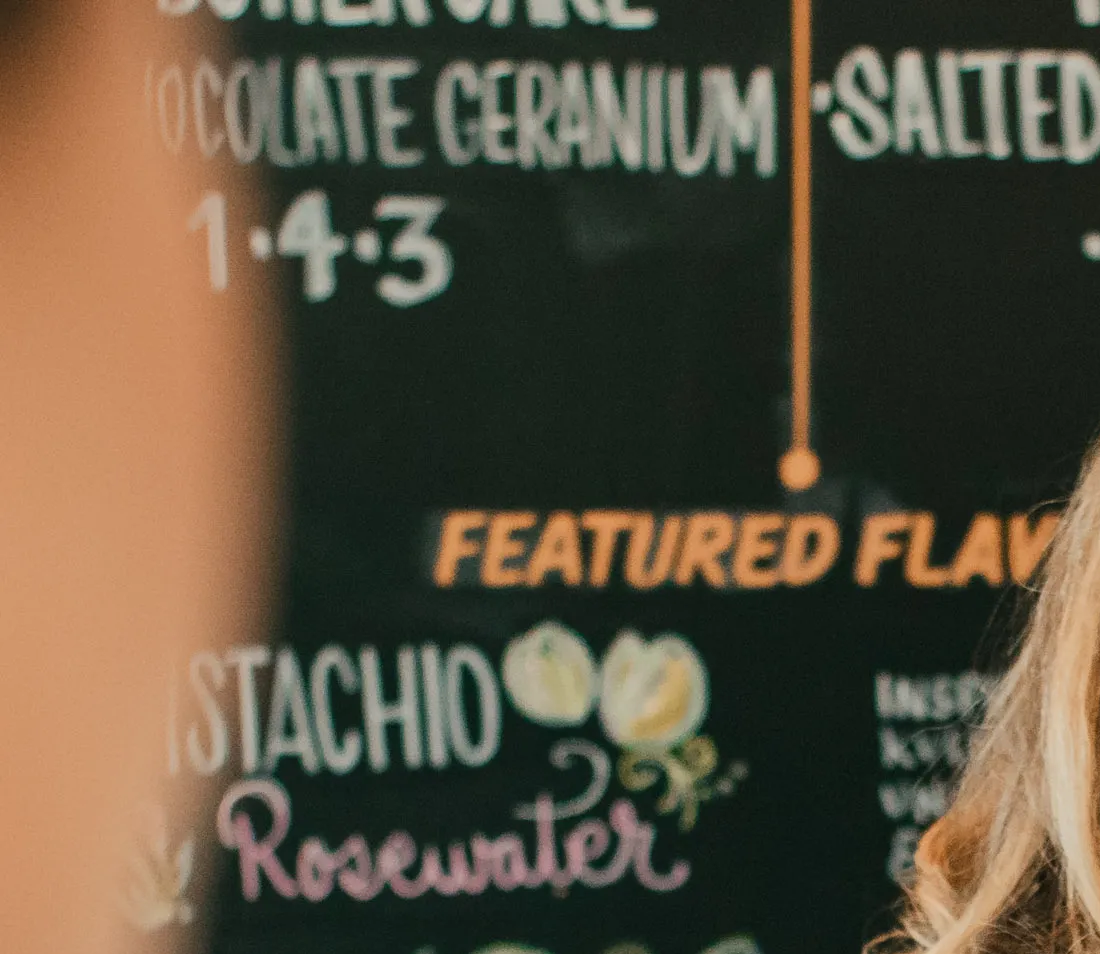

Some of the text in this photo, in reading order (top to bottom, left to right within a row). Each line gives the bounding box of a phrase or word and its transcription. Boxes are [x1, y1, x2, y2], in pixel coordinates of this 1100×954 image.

[146, 55, 777, 178] OCOLATE GERANIUM
[434, 510, 840, 589] FEATURED
[218, 760, 692, 901] Rosewater
